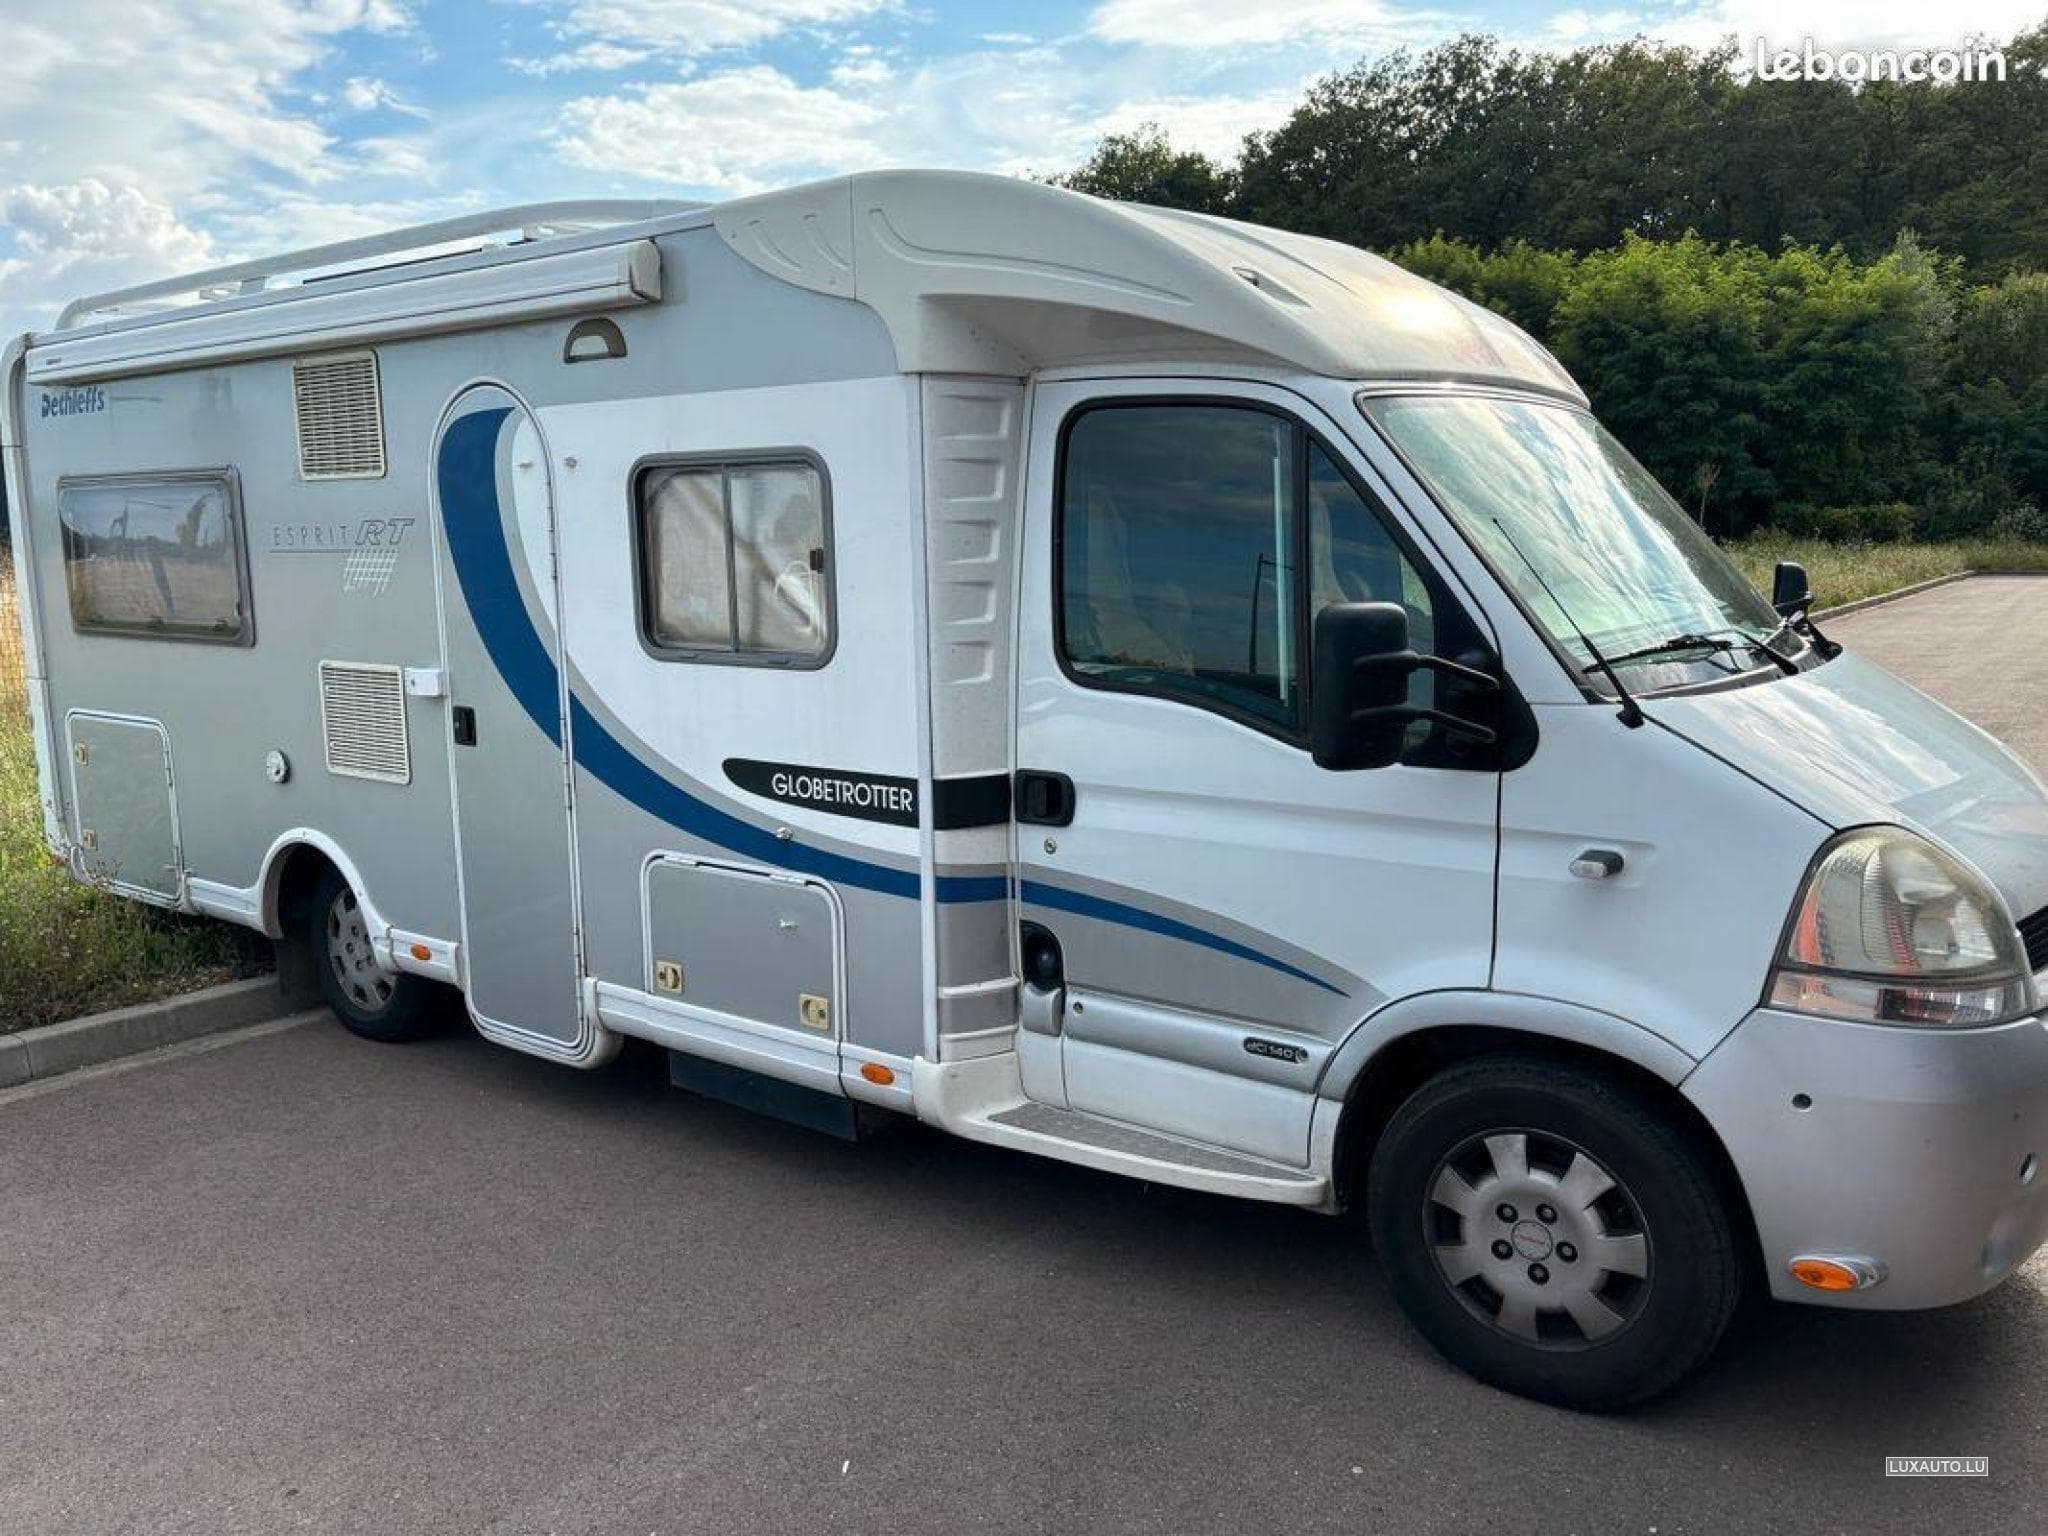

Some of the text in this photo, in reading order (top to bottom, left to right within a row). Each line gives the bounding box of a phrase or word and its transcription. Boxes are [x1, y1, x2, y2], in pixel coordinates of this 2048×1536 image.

[273, 518, 416, 546] ESPRIT RT
[771, 772, 913, 813] GLOBETROTTER
